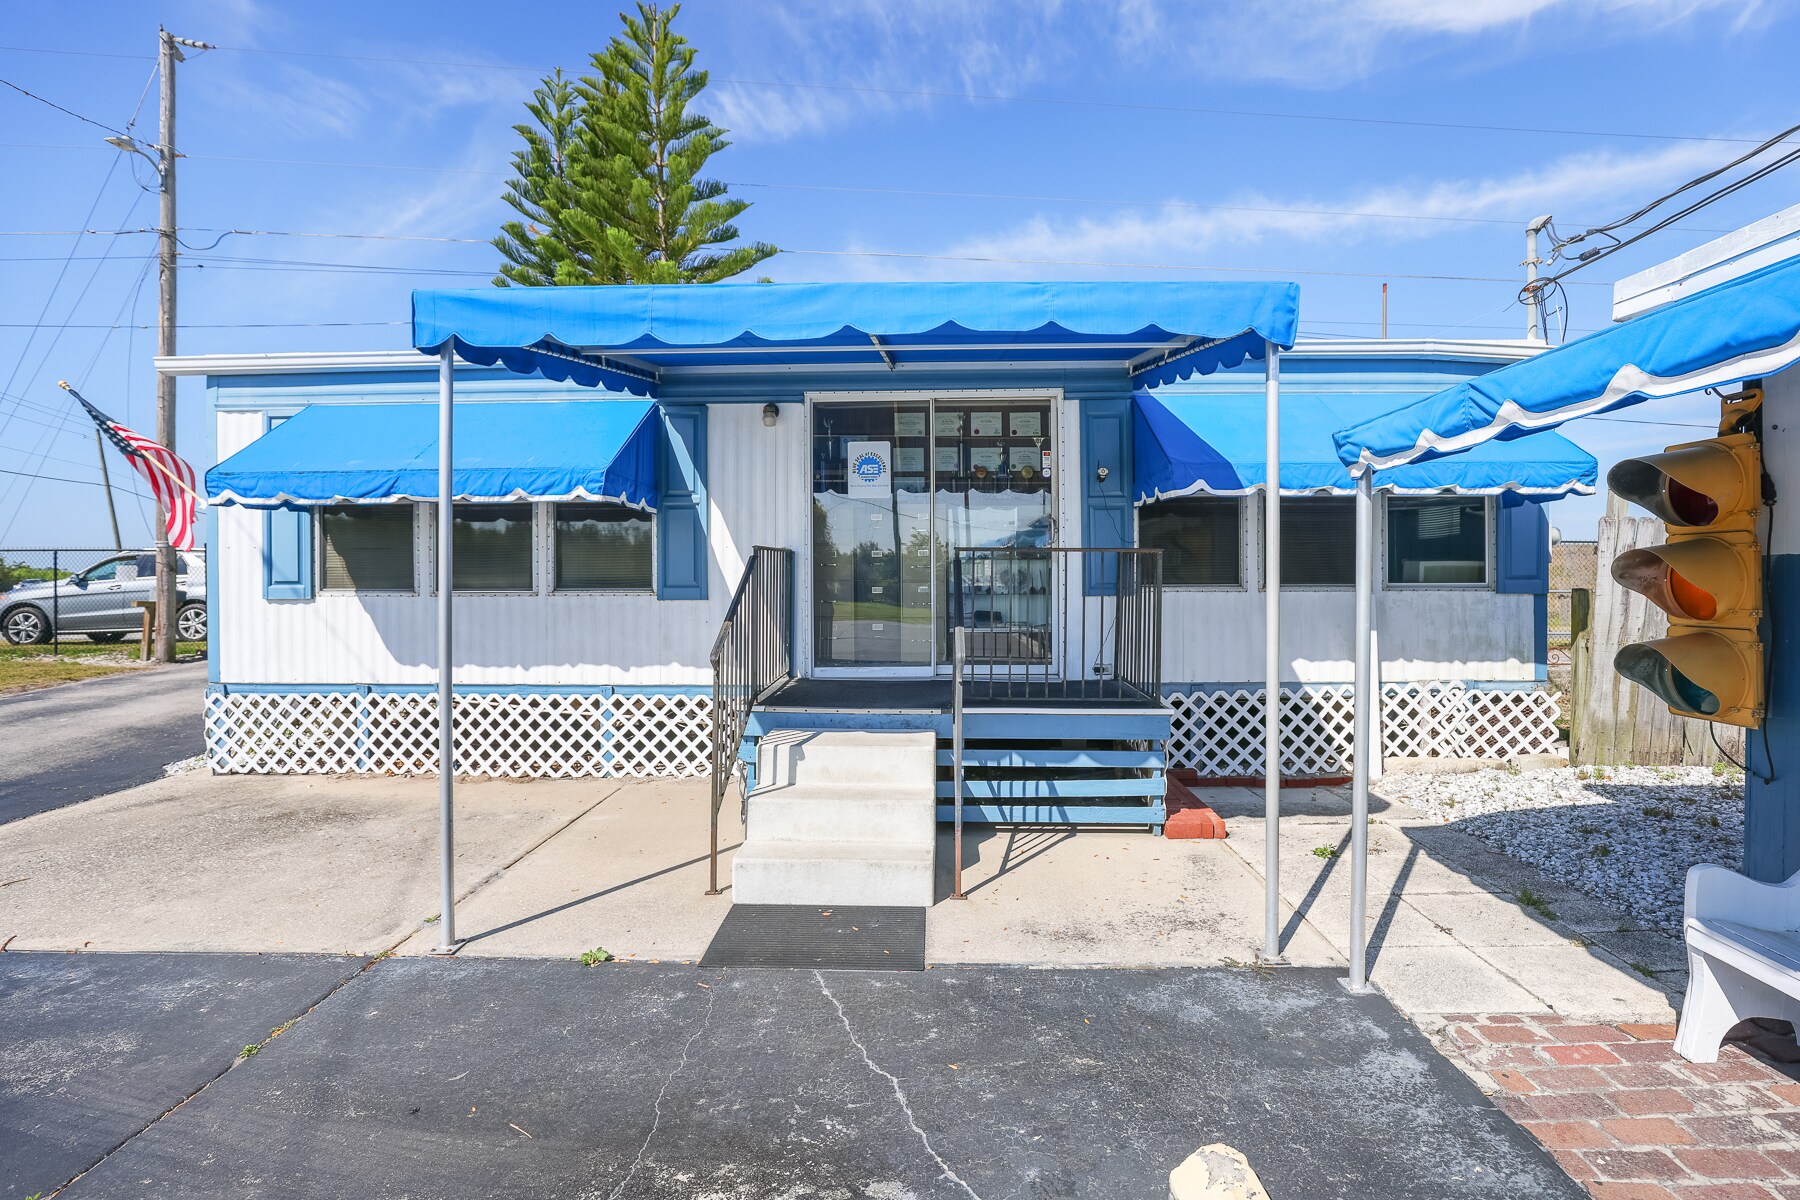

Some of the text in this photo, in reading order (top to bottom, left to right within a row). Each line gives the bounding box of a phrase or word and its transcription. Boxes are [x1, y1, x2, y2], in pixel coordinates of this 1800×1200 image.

[855, 454, 864, 462] SEAL
[870, 452, 887, 473] EXCELLENCE
[860, 464, 878, 474] ASE
